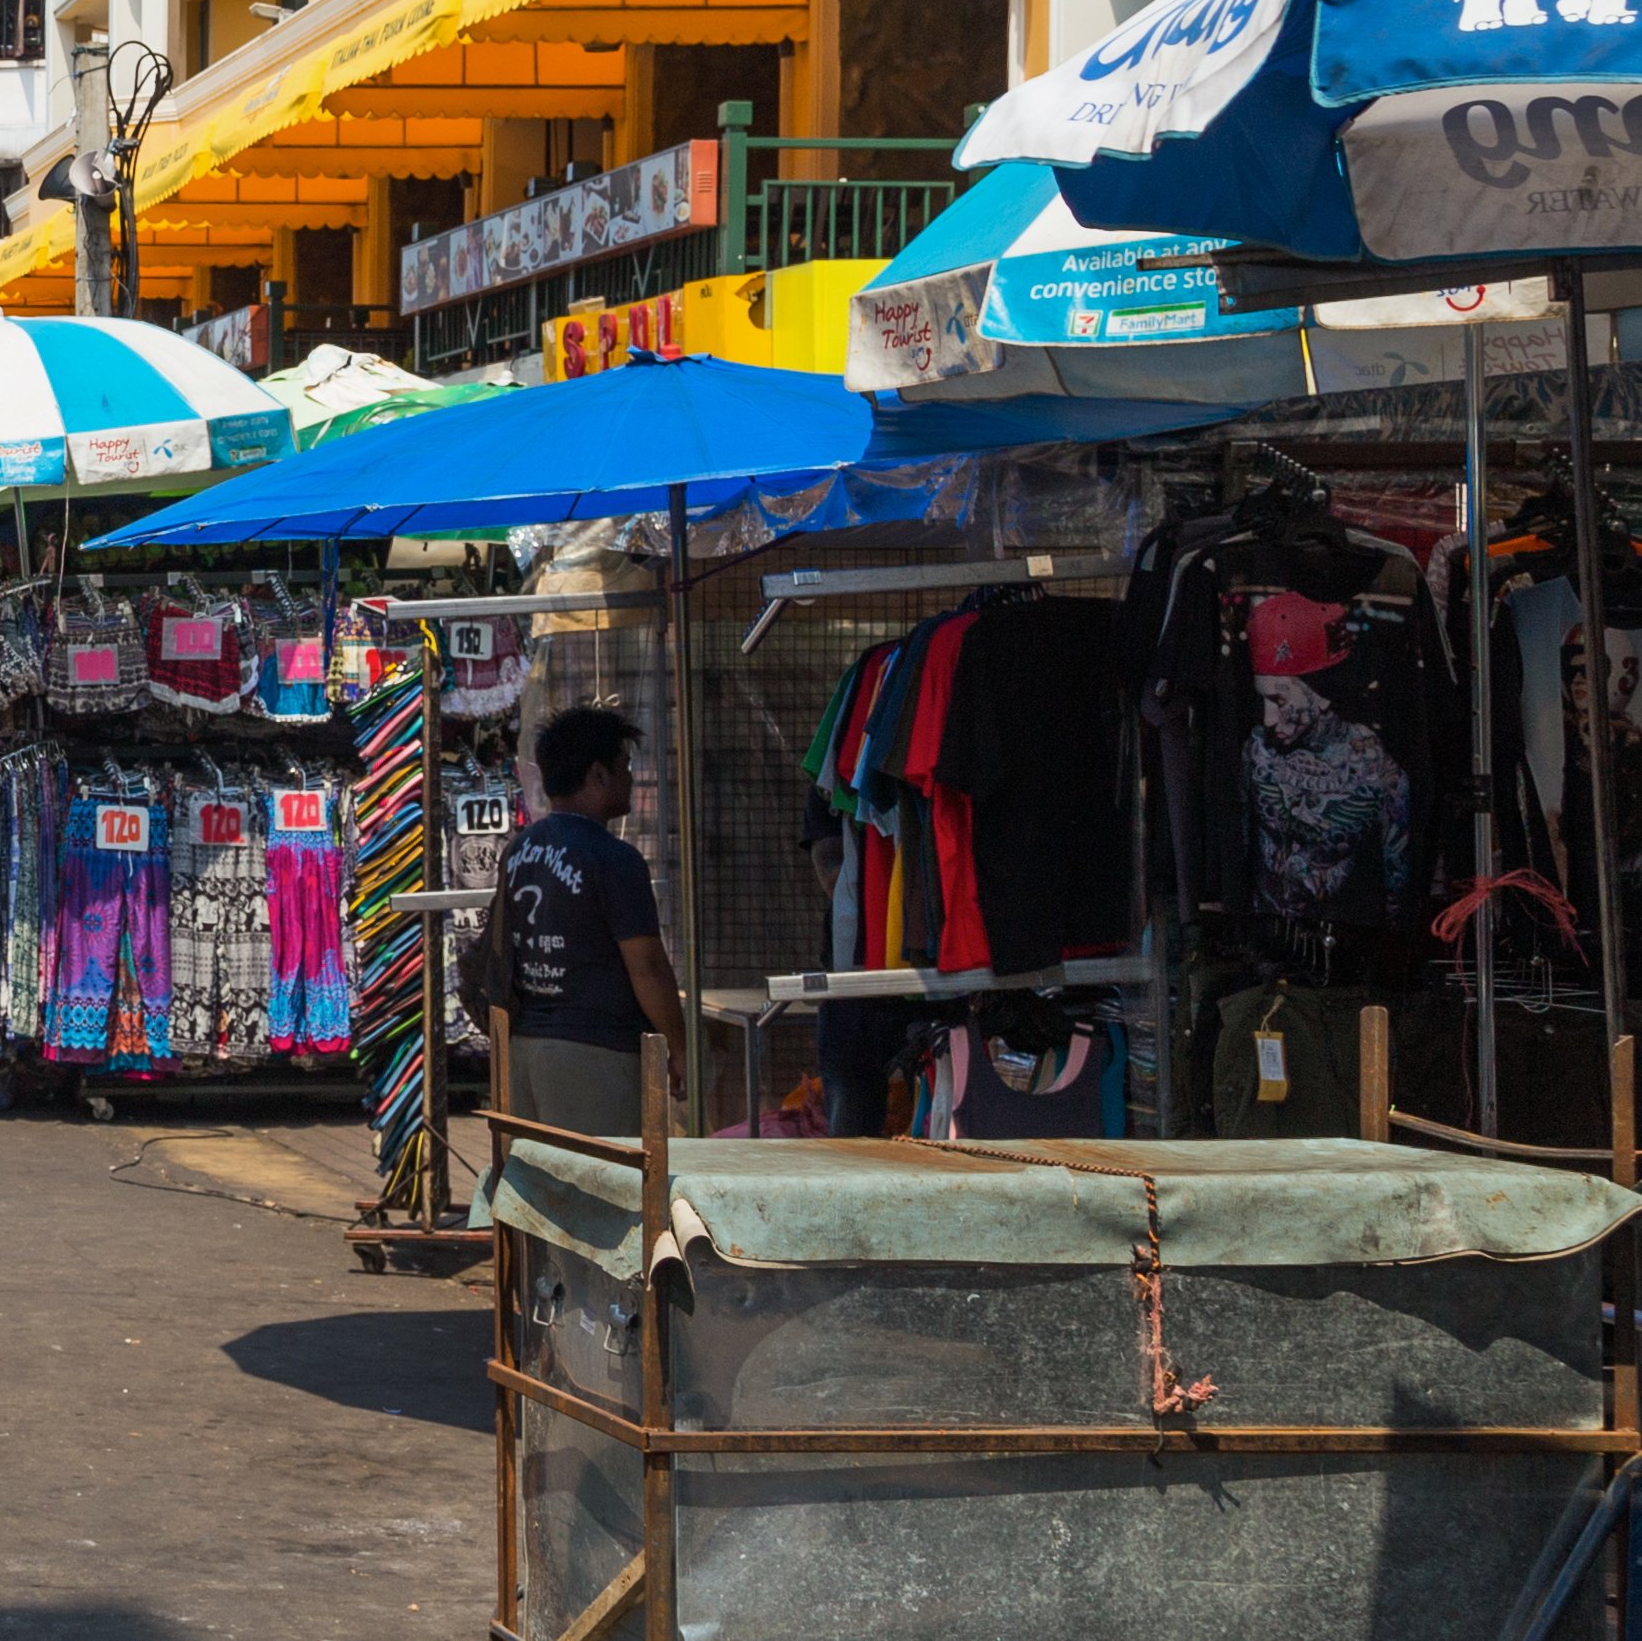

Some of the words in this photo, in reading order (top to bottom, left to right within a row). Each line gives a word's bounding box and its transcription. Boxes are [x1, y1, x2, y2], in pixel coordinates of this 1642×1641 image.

[1062, 245, 1152, 273] Available
[1030, 270, 1177, 301] convenience
[1182, 268, 1217, 289] sto
[875, 298, 920, 331] Happy
[1119, 312, 1197, 331] FamilyMart
[882, 325, 933, 349] Tourist
[89, 438, 130, 451] Happy
[96, 450, 140, 463] Tourist
[173, 621, 215, 654] 100
[101, 810, 141, 844] 120
[460, 799, 504, 830] 120
[545, 845, 582, 895] What
